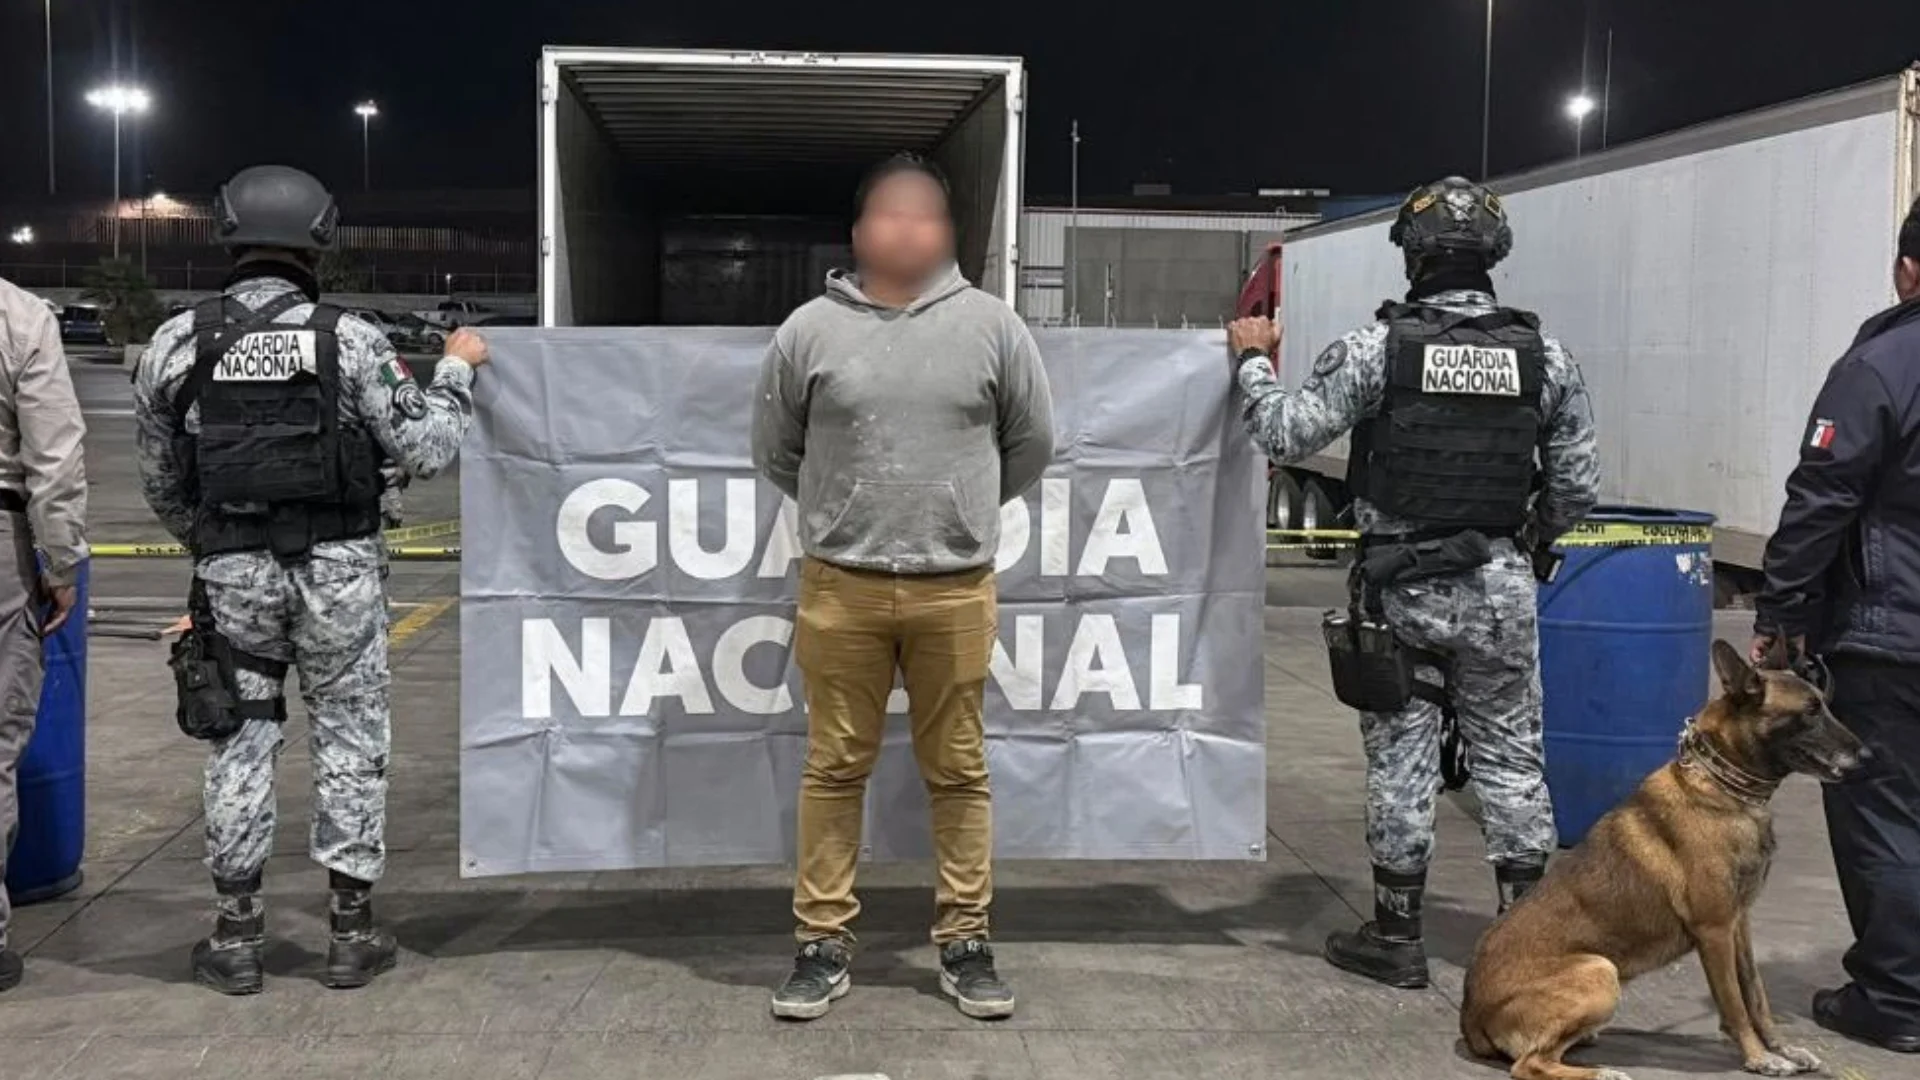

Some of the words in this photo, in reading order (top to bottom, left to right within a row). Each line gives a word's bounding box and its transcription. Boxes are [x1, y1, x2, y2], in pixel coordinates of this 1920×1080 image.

[1425, 369, 1517, 393] NACIONAL
[1431, 348, 1512, 370] GUARDIA
[556, 477, 1169, 581] GUIA
[521, 613, 1202, 718] NACNAL
